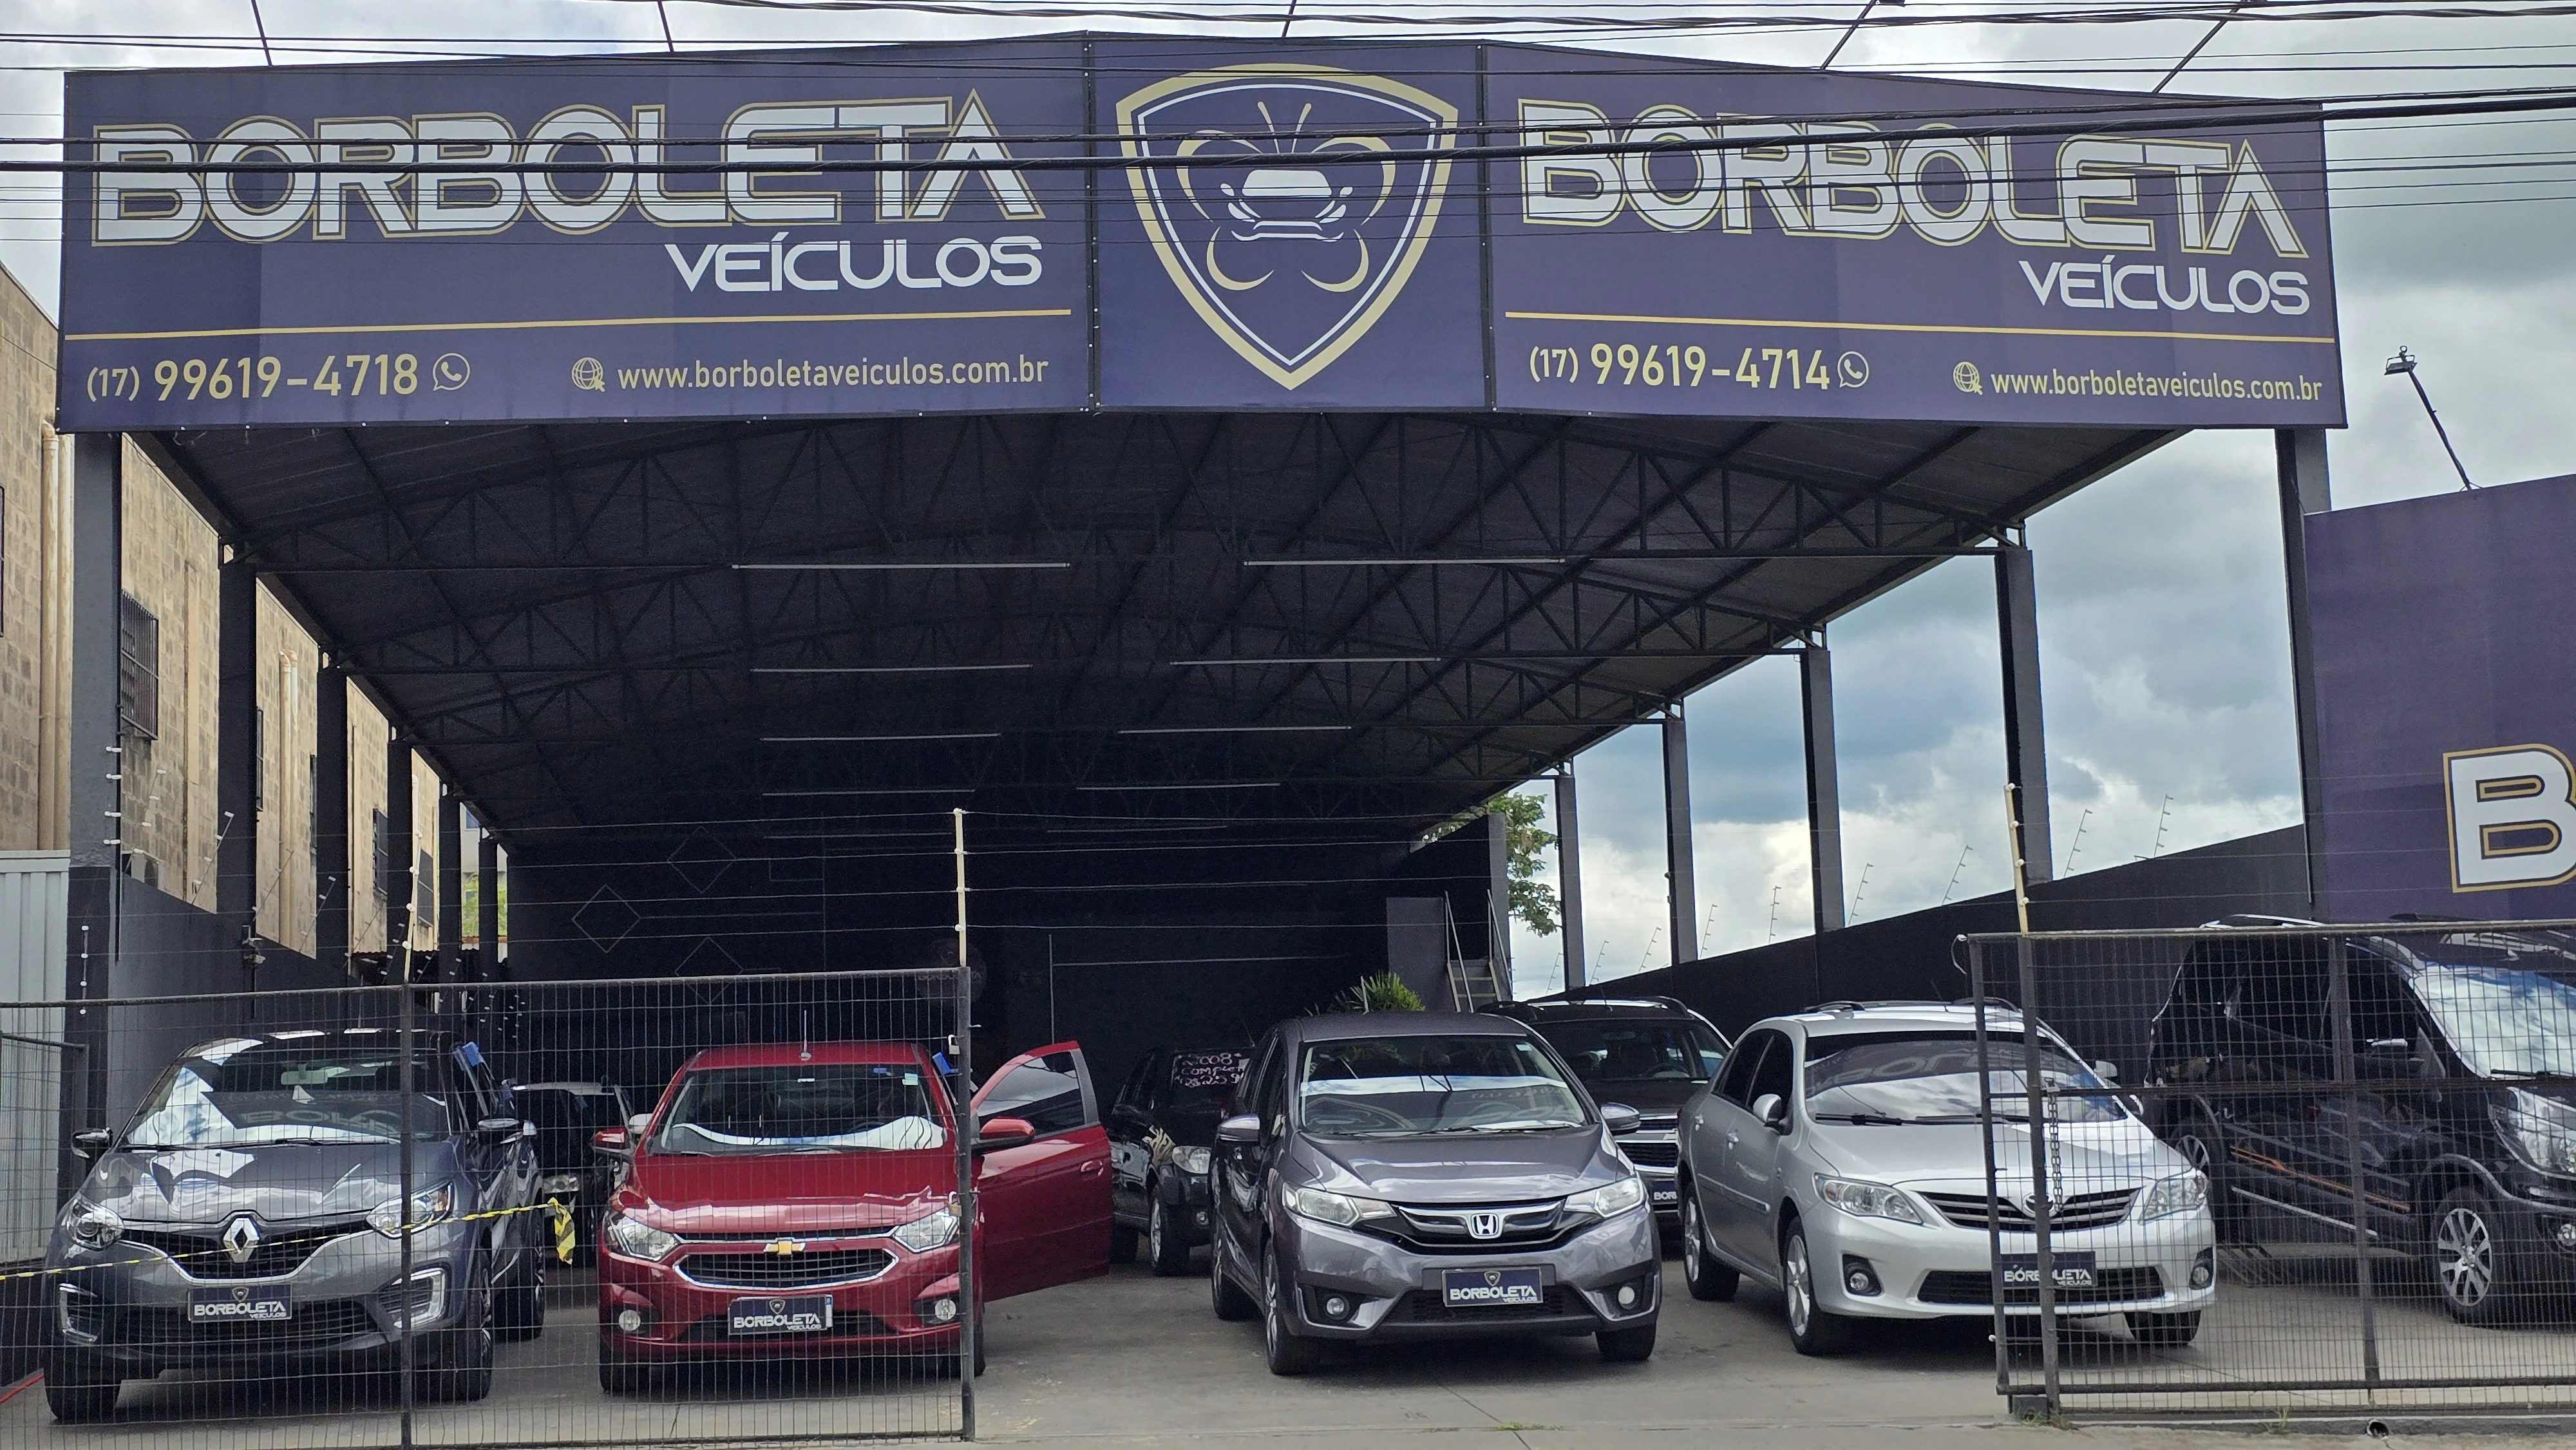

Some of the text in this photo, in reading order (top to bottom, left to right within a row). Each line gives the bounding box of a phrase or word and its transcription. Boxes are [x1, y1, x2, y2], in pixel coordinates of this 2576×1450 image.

[92, 88, 1046, 246] BORBOLETA
[1518, 99, 2309, 259] BORBOLETA
[665, 231, 1041, 292] VEÍCULOS
[2019, 255, 2309, 315] VEÍCULOS
[86, 353, 418, 402] (17) 99619-4718
[618, 354, 1049, 390] www.borboletaveiculos.com.br
[1530, 343, 1829, 390] (17) 99619-4714
[1992, 368, 2322, 401] www.borboletaveiculos.com.br
[194, 1301, 286, 1316] BORBOLETA
[1450, 1285, 1537, 1300] BORBOLETA
[734, 1313, 820, 1328] BORBOLETA
